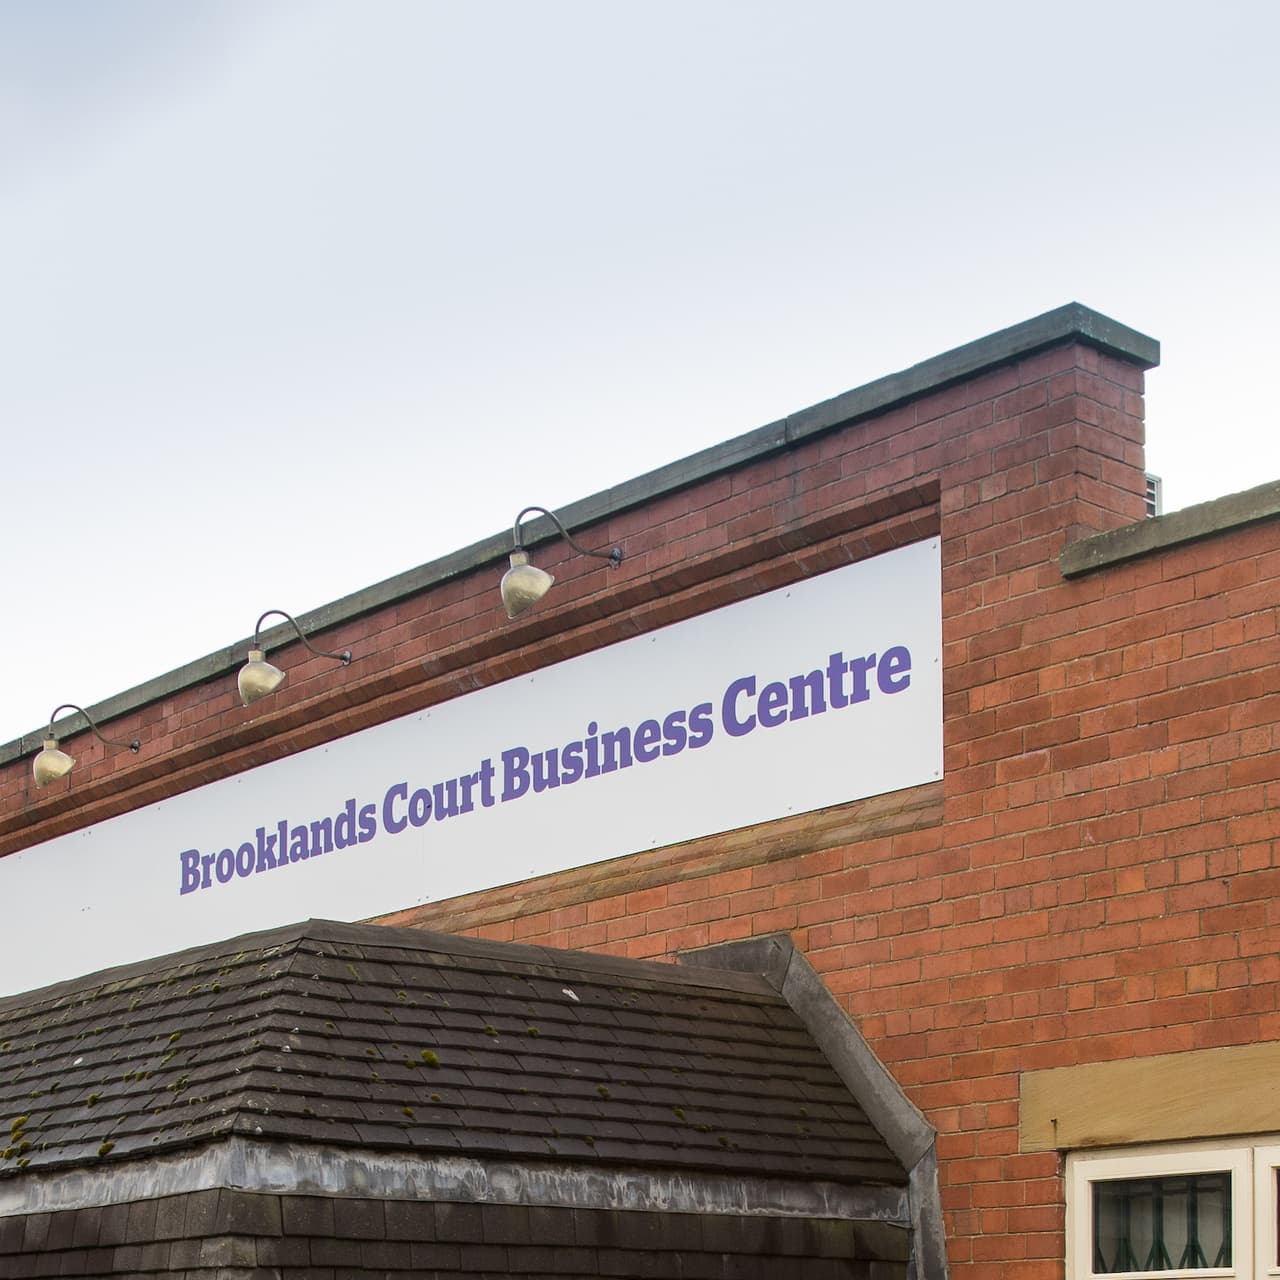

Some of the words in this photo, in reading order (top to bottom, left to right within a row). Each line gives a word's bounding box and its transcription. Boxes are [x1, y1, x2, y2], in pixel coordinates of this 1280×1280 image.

[180, 798, 377, 896] Brooklands
[383, 758, 495, 835] Court
[501, 702, 714, 803] Business
[720, 644, 913, 738] Centre
